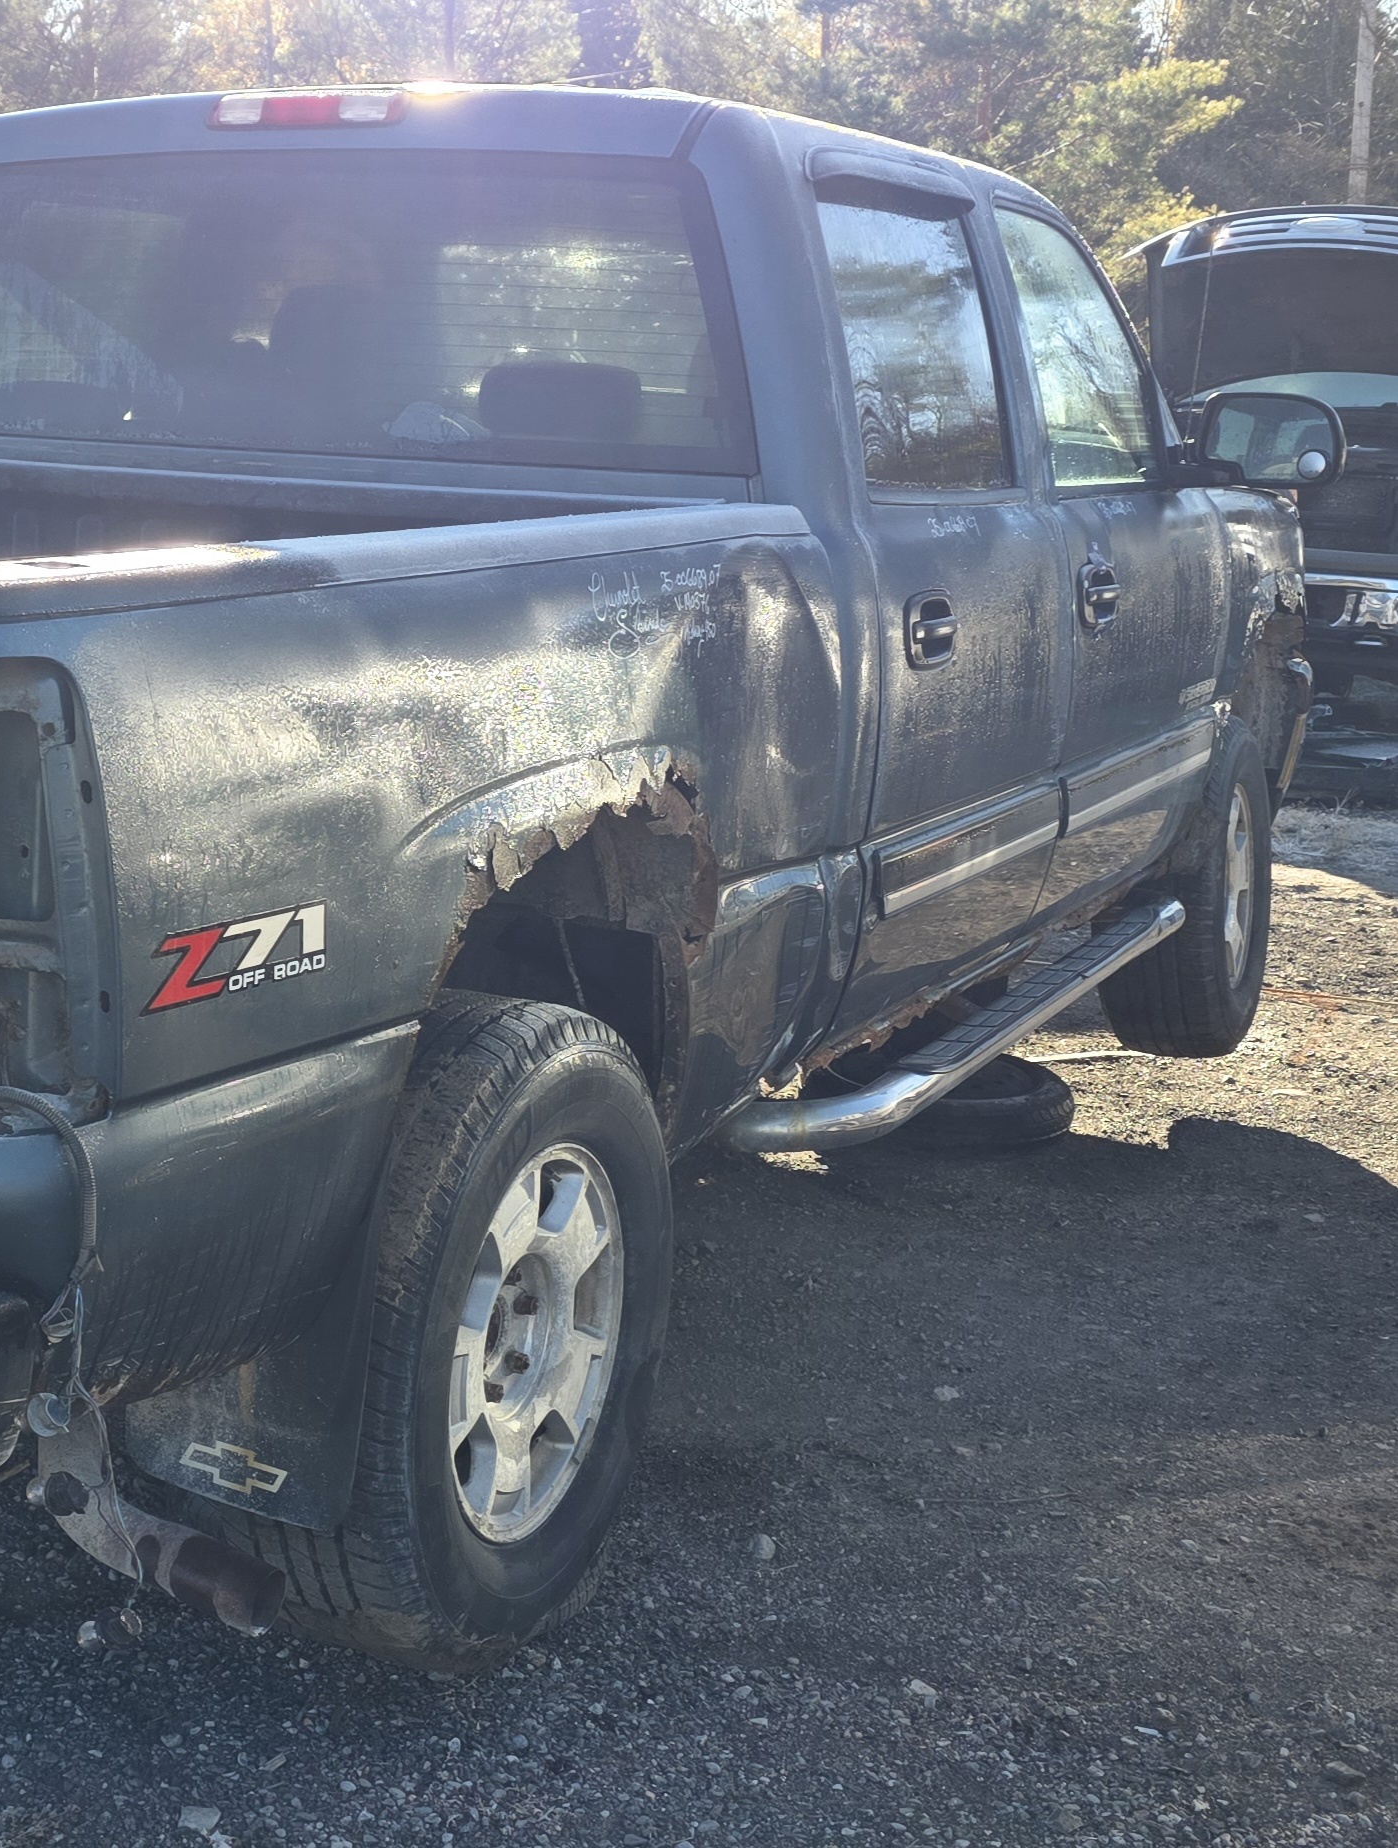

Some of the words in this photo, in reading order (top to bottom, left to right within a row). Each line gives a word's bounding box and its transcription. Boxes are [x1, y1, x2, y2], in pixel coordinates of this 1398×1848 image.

[142, 900, 326, 1012] Z71
[228, 967, 265, 991] OFF
[273, 953, 325, 982] ROAD
